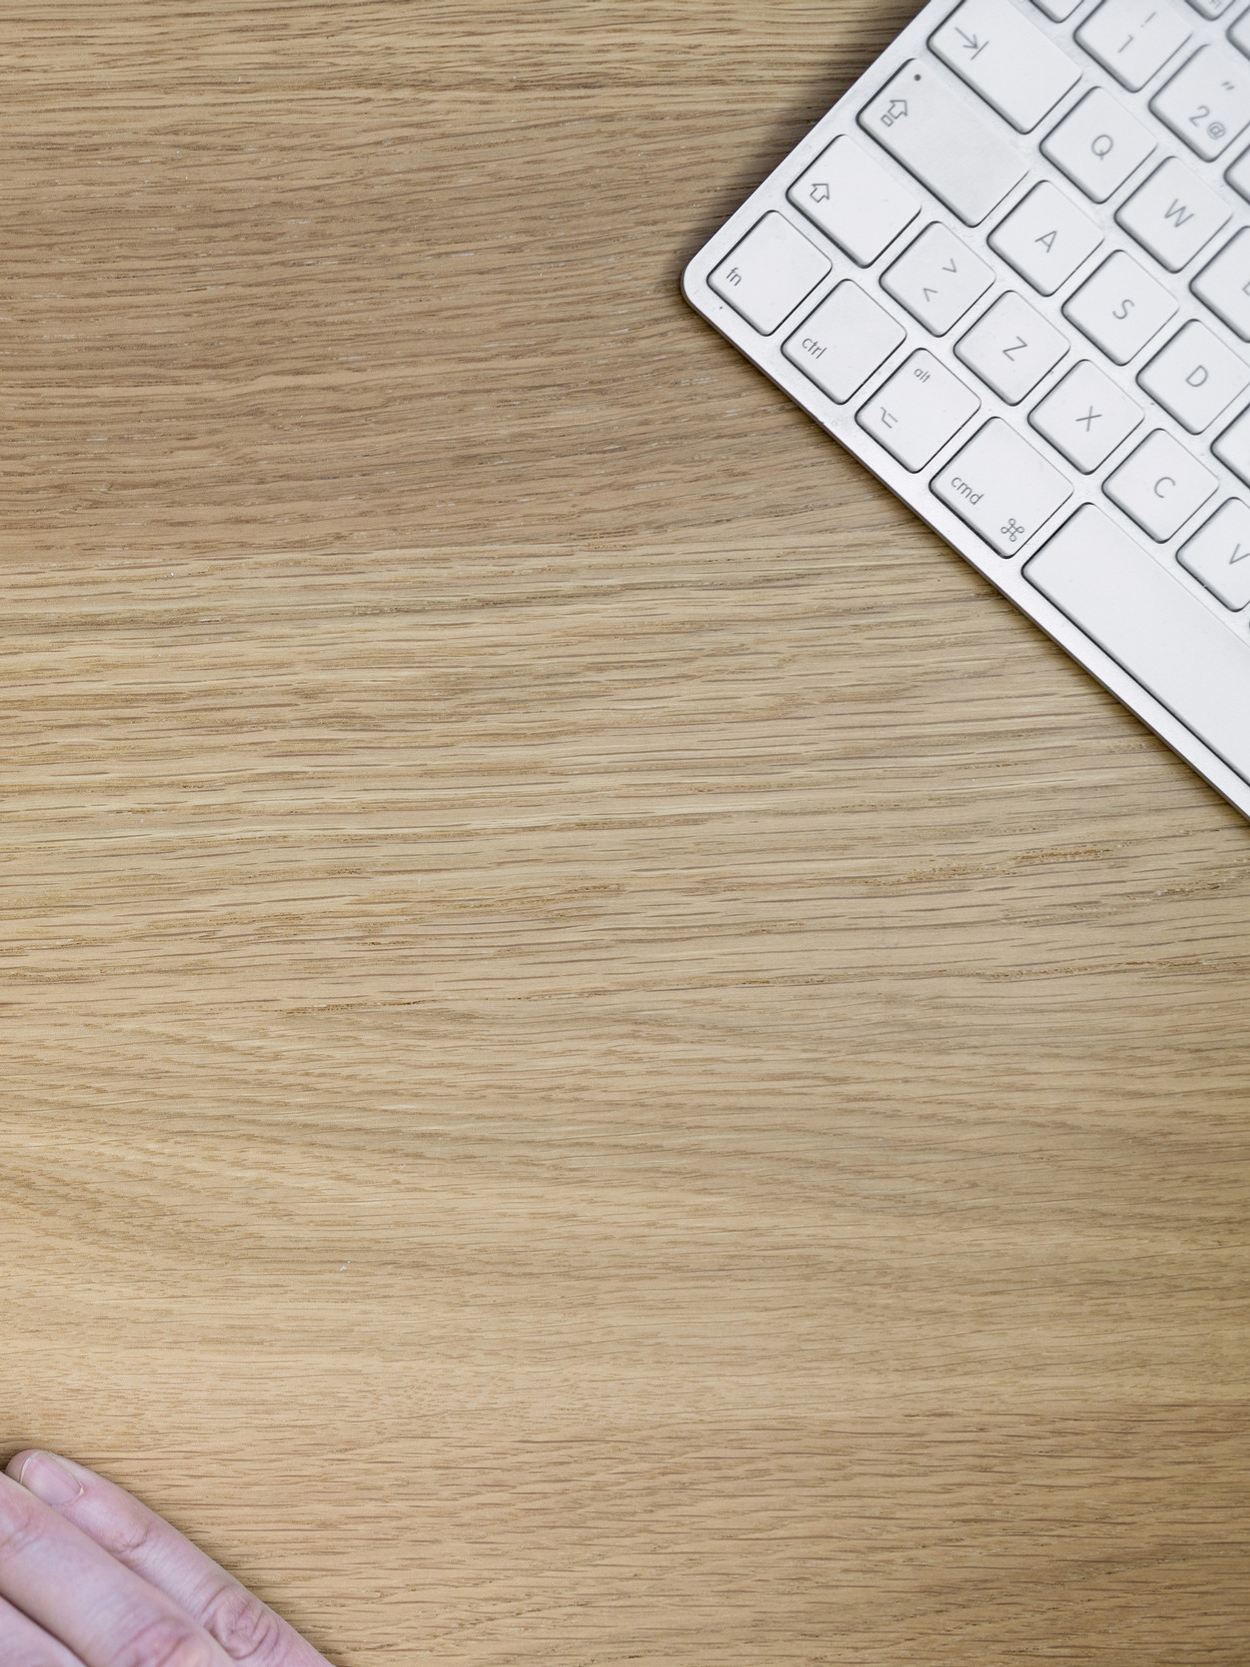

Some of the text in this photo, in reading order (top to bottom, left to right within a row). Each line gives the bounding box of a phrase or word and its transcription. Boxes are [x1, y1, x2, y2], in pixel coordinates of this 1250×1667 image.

[1117, 34, 1134, 54] 1
[1091, 134, 1114, 161] Q
[1163, 198, 1195, 228] W
[1034, 230, 1057, 254] A
[725, 266, 743, 287] fn
[1112, 299, 1135, 320] S
[801, 338, 828, 360] ctrl
[1002, 336, 1029, 362] Z
[913, 368, 932, 384] alt
[1185, 365, 1209, 388] D
[1075, 405, 1103, 432] X
[950, 476, 985, 506] cmd
[1153, 476, 1177, 499] C
[1228, 543, 1250, 565] V
